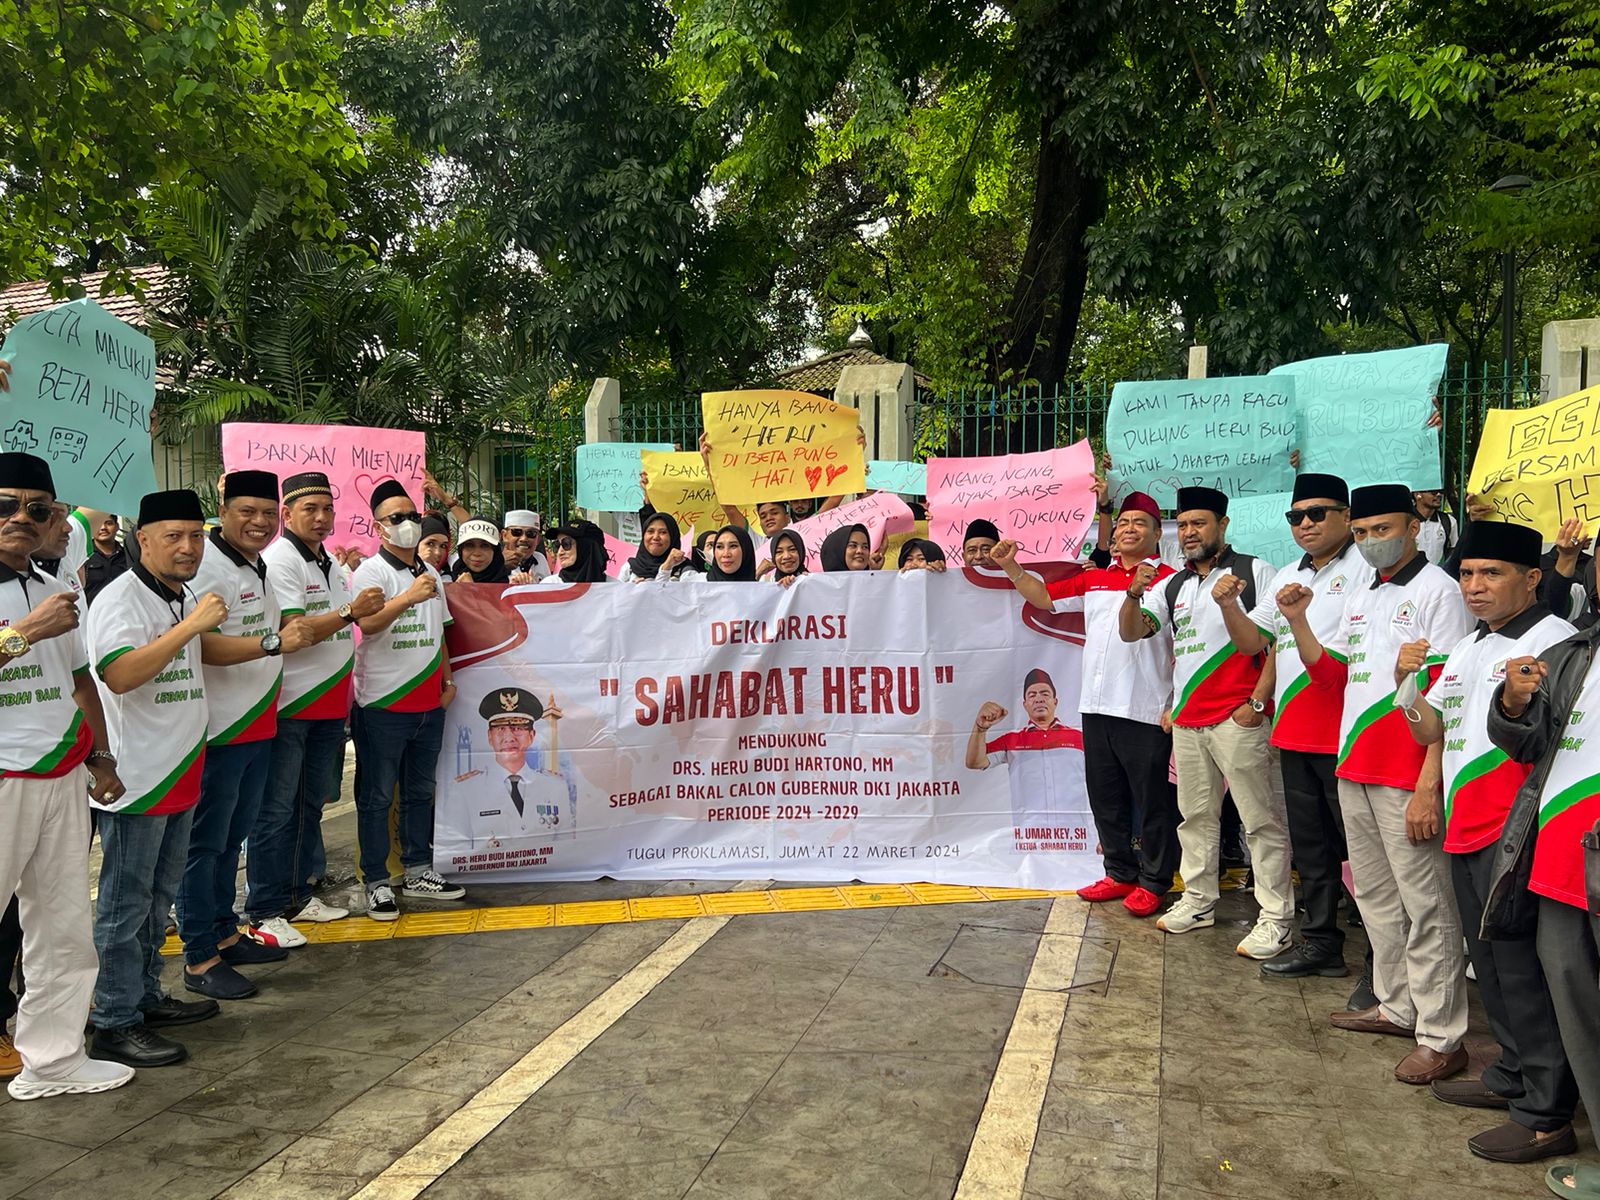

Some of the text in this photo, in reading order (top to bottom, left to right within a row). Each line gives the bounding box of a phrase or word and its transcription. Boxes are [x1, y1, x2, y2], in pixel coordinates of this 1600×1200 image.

[94, 328, 152, 381] MALUKU
[38, 361, 153, 434] BETA HERU
[1122, 391, 1289, 417] KAMI TANPA RAGU
[718, 400, 781, 424] HANYA
[1123, 424, 1190, 451] DUKUNG
[1204, 421, 1250, 439] HERU
[247, 439, 422, 480] BARISAN MILENIAL
[621, 450, 641, 460] MEL
[722, 444, 838, 468] DI BETA PUNG
[1118, 452, 1272, 478] UNTUK JAKARTA LEBIH
[751, 468, 795, 489] HATI
[1005, 484, 1063, 501] BABE
[1008, 507, 1086, 529] DUKUNG
[710, 614, 848, 646] DEKLARASI
[0, 664, 43, 682] KARTA
[633, 666, 808, 727] SAHABAT
[821, 665, 922, 716] HERU
[738, 732, 828, 750] MENDUKUNG
[672, 756, 894, 776] DRS. HERU BUDI HARTONO, MM
[608, 781, 961, 809] SEBAGAI BAKAL CALON GUBERNUR DKI JAKARTA
[707, 805, 771, 822] PERIODE
[776, 805, 812, 820] 2024
[1025, 828, 1052, 840] UMAR
[1054, 828, 1073, 840] KEY,
[1074, 828, 1087, 840] SH
[452, 847, 554, 865] DRS. HERU BUDI HARTONO, MM
[626, 844, 960, 861] TUGU PROKLAMASI, JUM'AT 22 MARET 2024
[469, 862, 505, 871] GUBERNUR
[506, 860, 518, 868] DKI
[519, 857, 547, 867] JAKARTA
